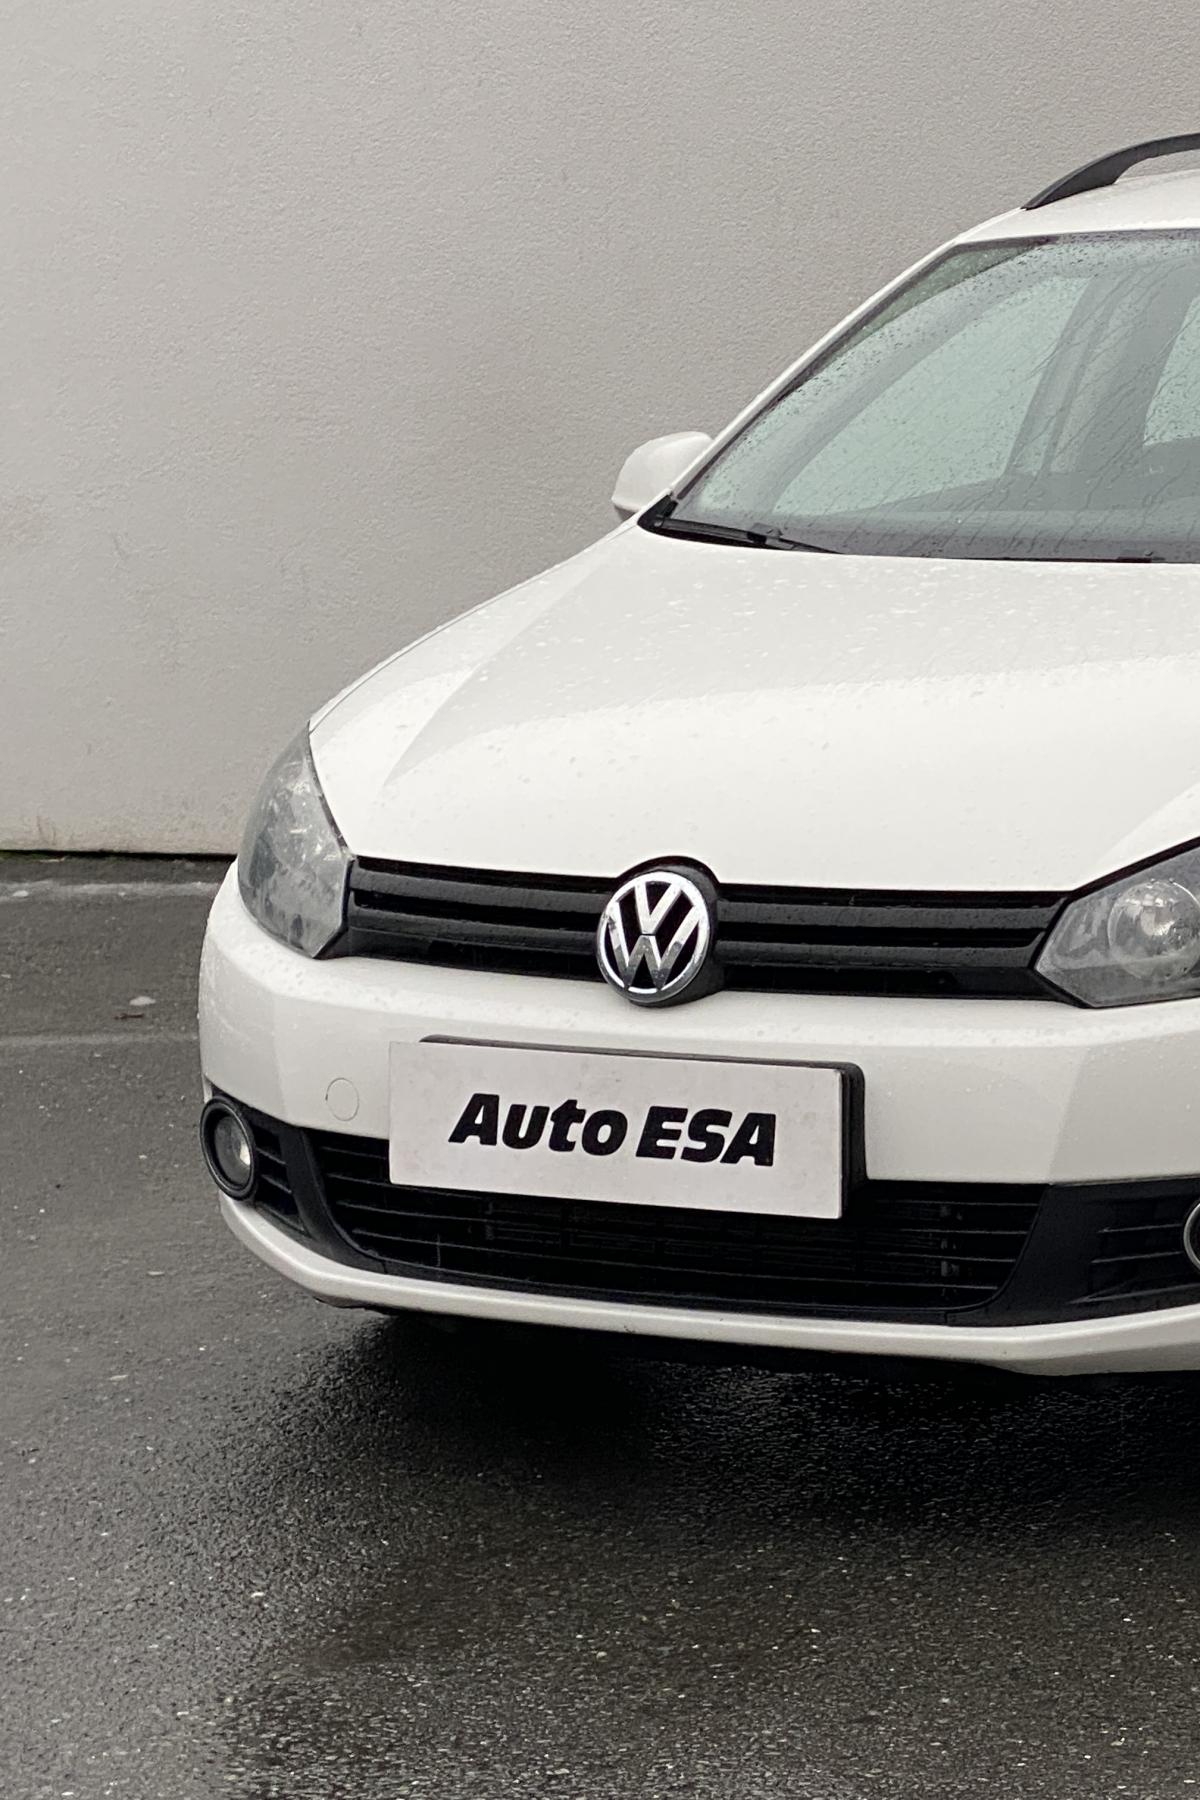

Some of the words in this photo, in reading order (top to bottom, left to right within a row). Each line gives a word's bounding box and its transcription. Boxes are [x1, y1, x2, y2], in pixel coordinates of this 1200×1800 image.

[601, 873, 707, 996] VW
[447, 1093, 628, 1157] Auto
[635, 1105, 777, 1167] ESA
